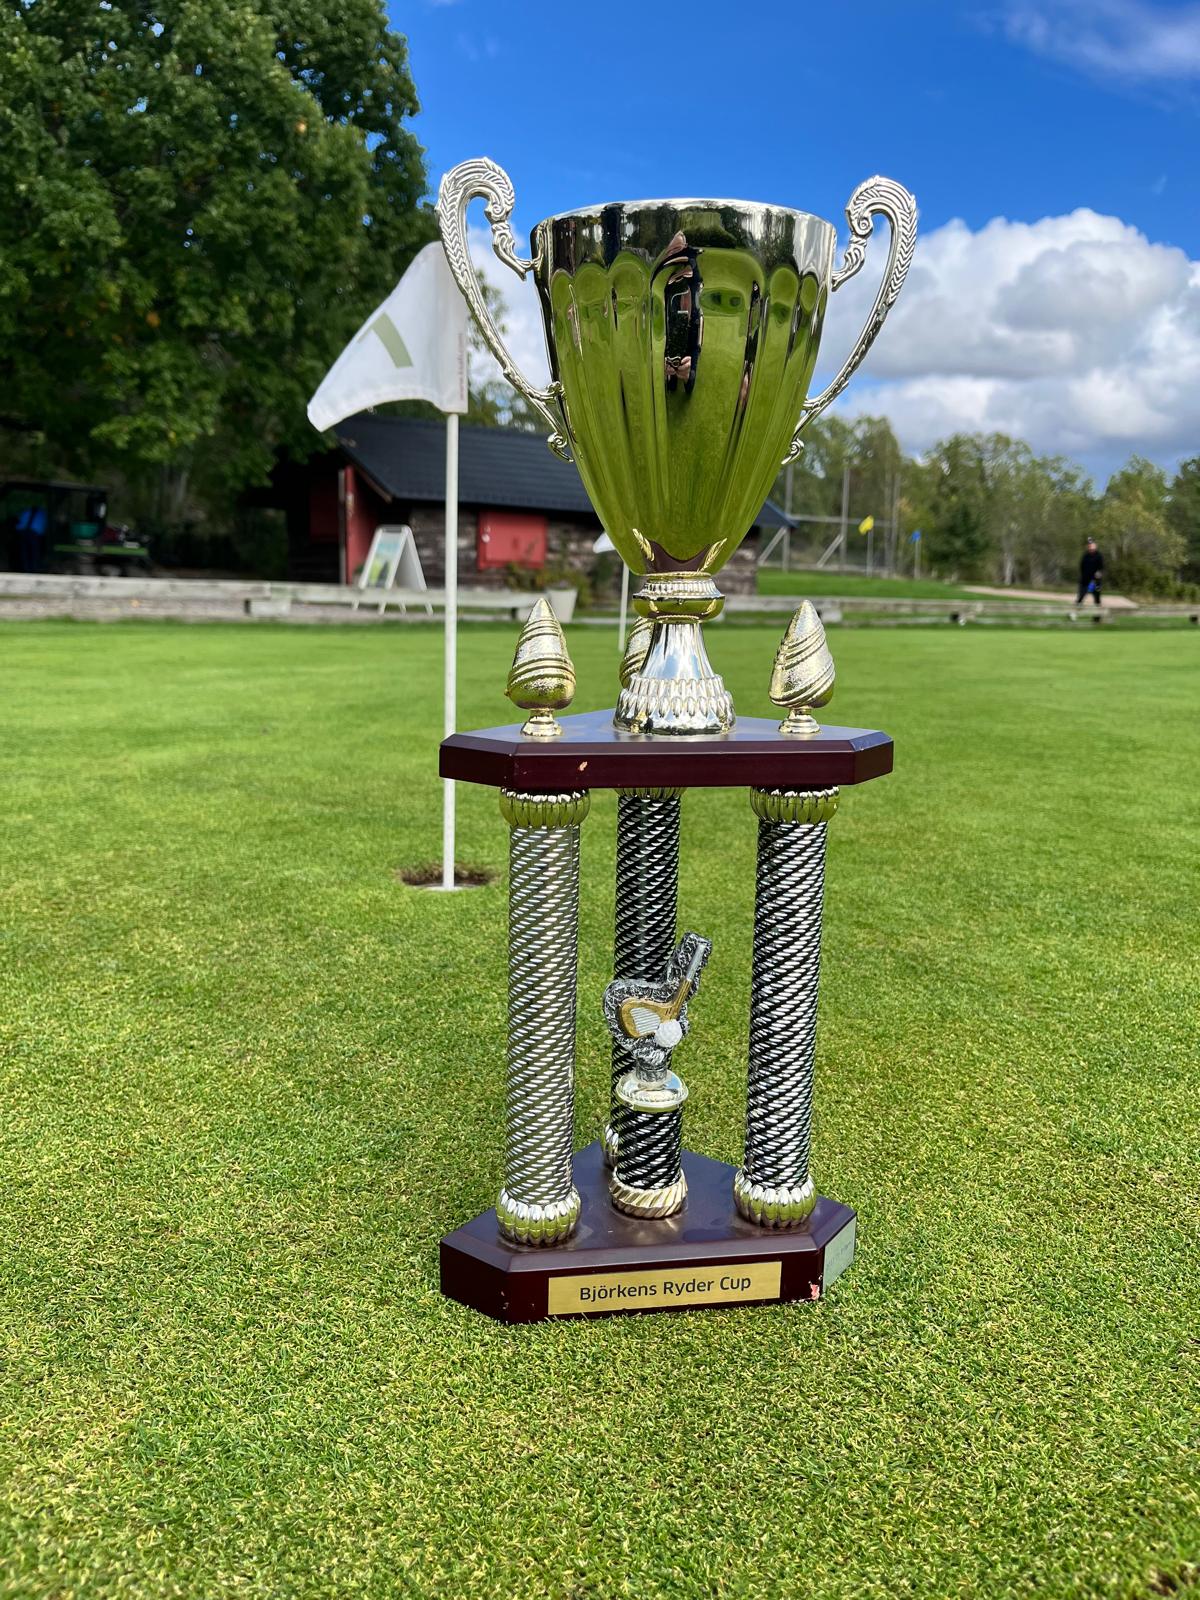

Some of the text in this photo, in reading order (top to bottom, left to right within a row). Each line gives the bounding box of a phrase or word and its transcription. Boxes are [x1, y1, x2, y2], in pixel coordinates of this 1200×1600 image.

[580, 1276, 752, 1303] Björkens Ryder Cup
